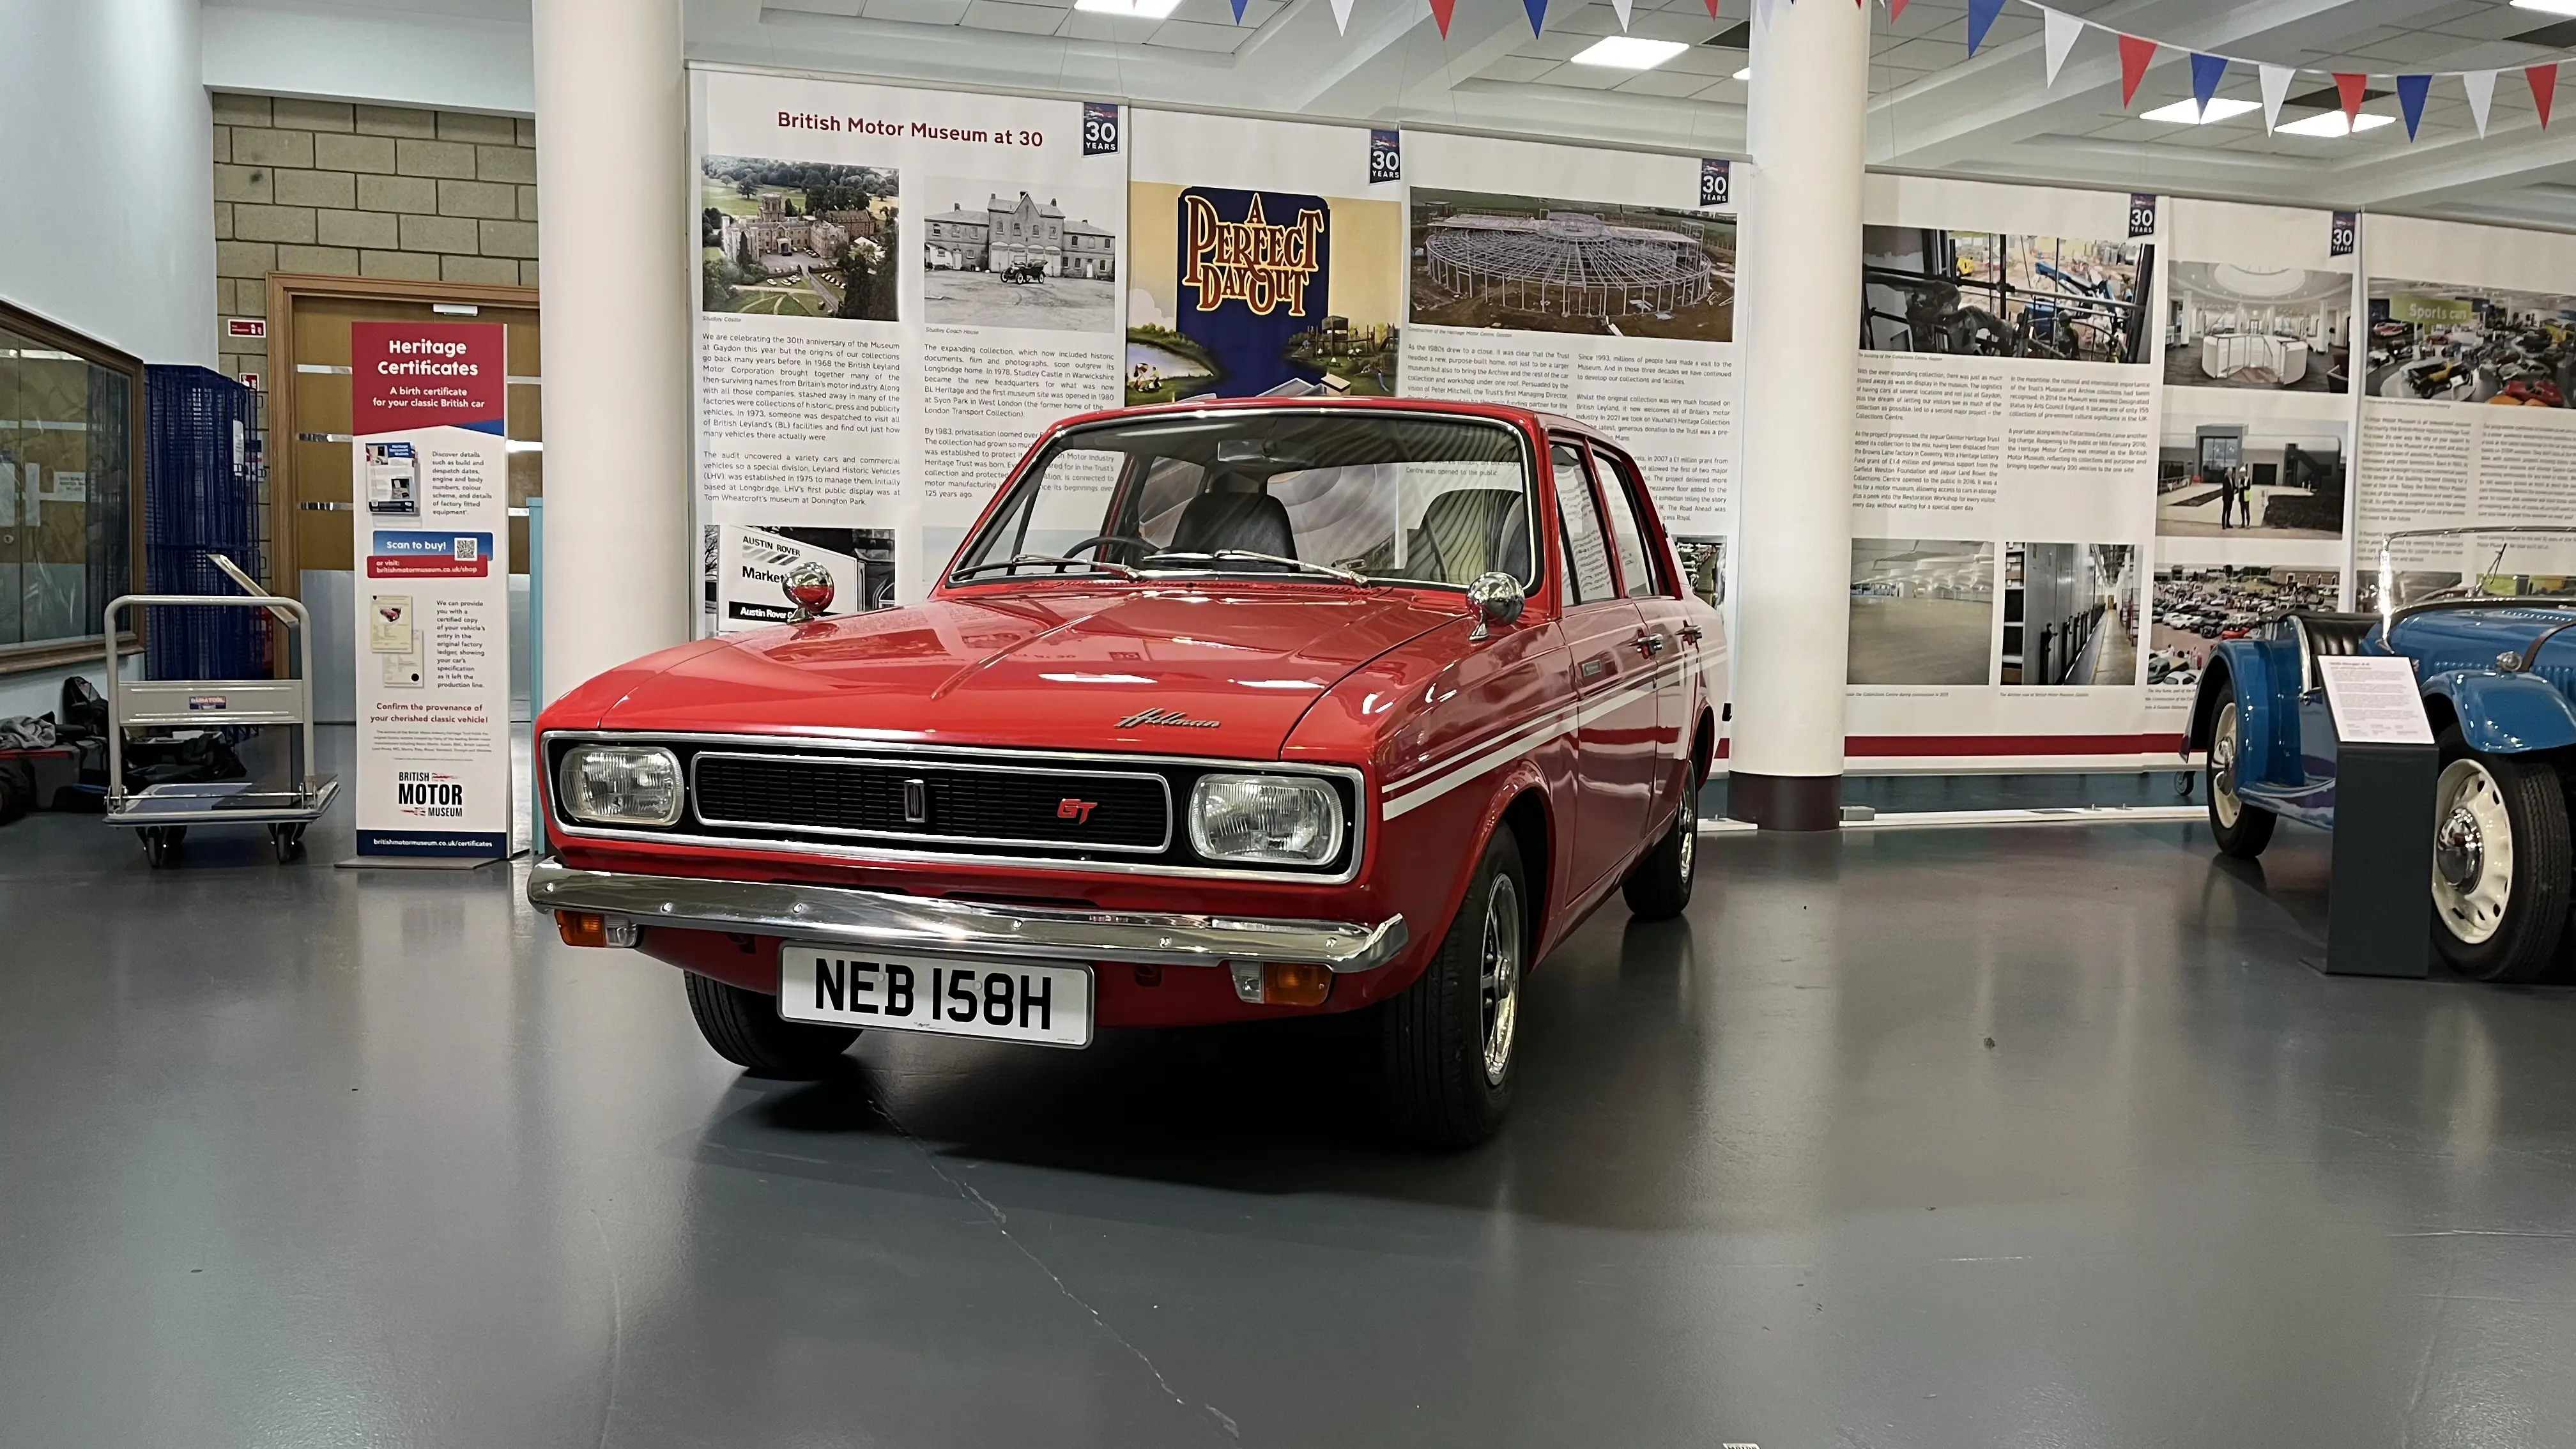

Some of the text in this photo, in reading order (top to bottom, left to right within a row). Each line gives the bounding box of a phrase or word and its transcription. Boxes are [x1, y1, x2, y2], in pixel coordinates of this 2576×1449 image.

[778, 111, 1042, 146] British Motor Museum at 30
[1085, 121, 1116, 142] 30
[1086, 142, 1116, 151] YEARS
[1372, 150, 1399, 171] 30
[1372, 170, 1399, 178] YEARS
[1702, 175, 1726, 194] 30
[1244, 193, 1266, 226] A
[2131, 209, 2153, 227] 30
[1183, 196, 1324, 285] PERFECT
[2333, 228, 2353, 247] 30
[1197, 263, 1309, 316] DAY OUT
[2410, 303, 2446, 320] Sports
[389, 338, 466, 358] Heritage
[713, 344, 740, 352] Gaydon
[730, 334, 770, 344] celebrating
[806, 339, 845, 348] anniversary
[940, 346, 975, 354] expanding
[378, 359, 478, 376] Certificates
[390, 386, 467, 395] A birth certificate
[372, 397, 386, 406] for
[388, 400, 408, 408] your
[410, 398, 438, 407] classic
[441, 399, 468, 407] British
[424, 541, 446, 552] buy!
[742, 536, 801, 556] AUSTIN ROVER
[740, 607, 765, 617] Austin
[766, 609, 787, 618] Rover
[1114, 707, 1221, 729] Hillman
[399, 772, 429, 781] BRITISH
[399, 783, 462, 805] MOTOR
[428, 807, 462, 816] MUSEUM
[1057, 799, 1098, 825] GT
[816, 958, 1052, 1030] NEB 158H
